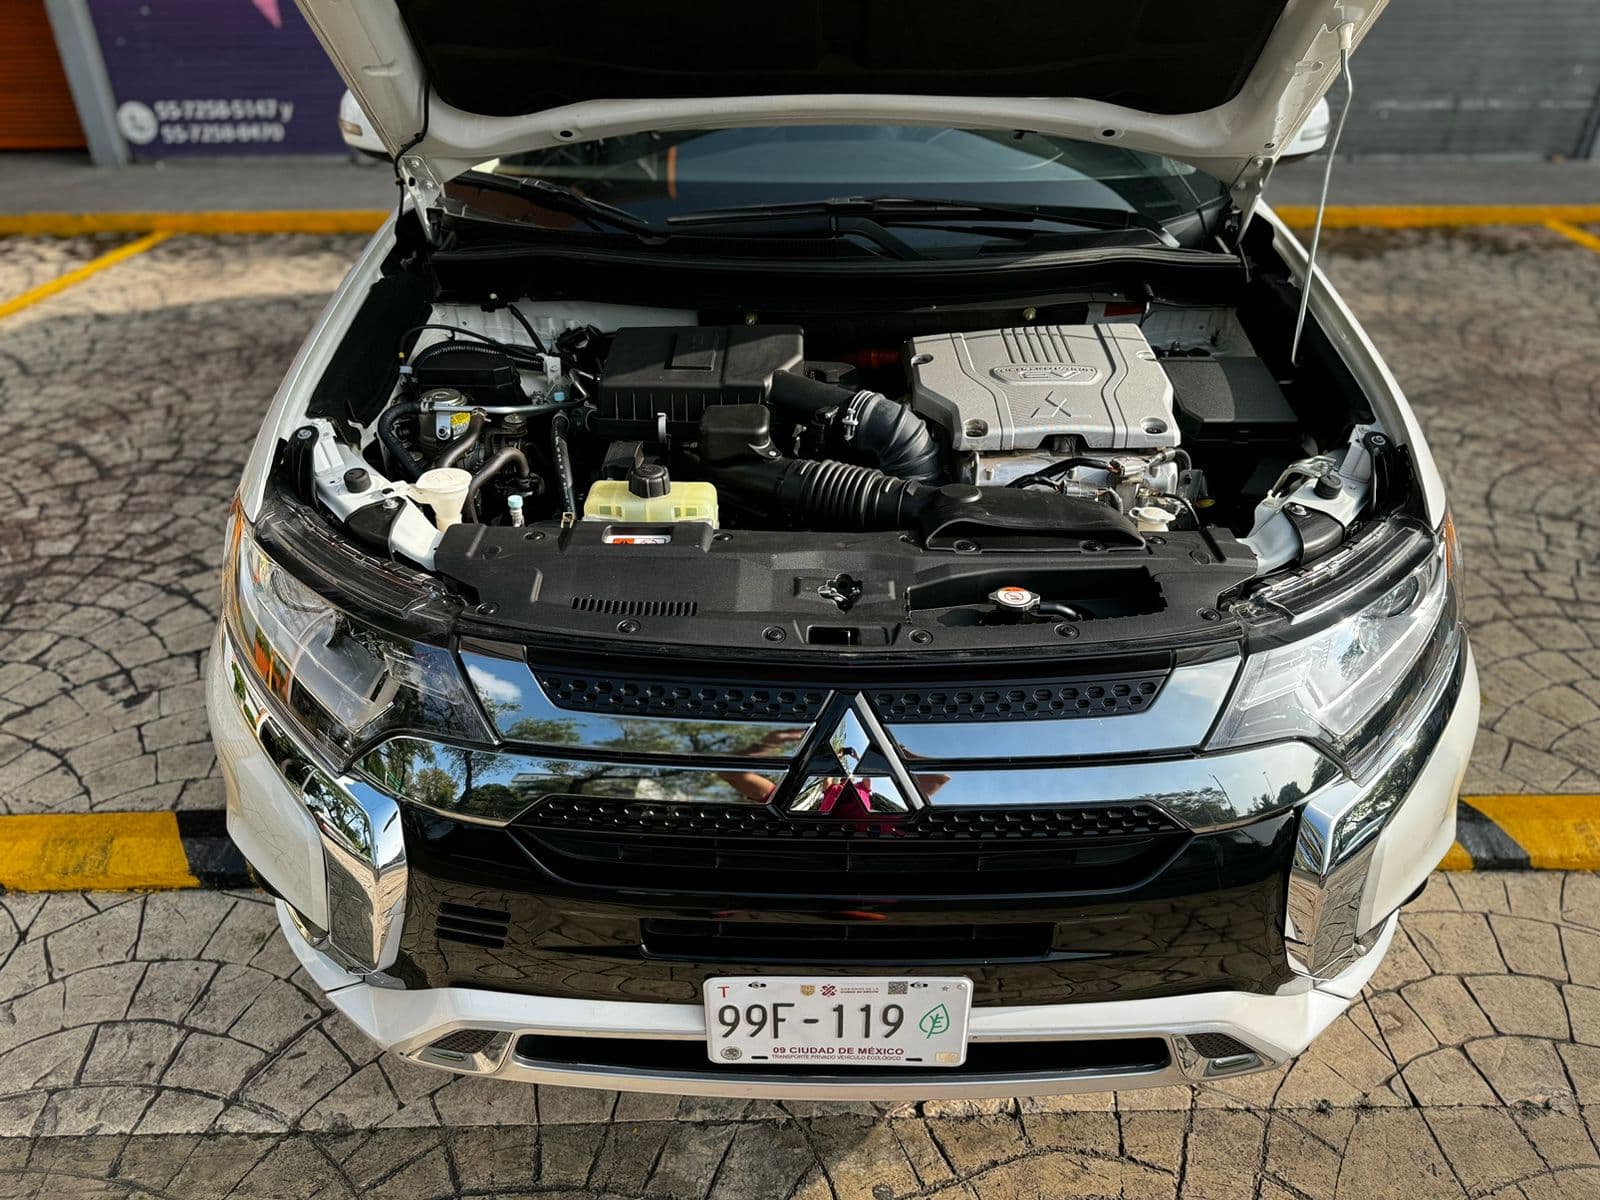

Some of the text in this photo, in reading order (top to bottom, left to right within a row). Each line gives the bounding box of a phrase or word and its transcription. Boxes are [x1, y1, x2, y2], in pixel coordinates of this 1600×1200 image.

[717, 987, 730, 998] T
[772, 1046, 905, 1056] 09 CIUDAD DE MÉXICO
